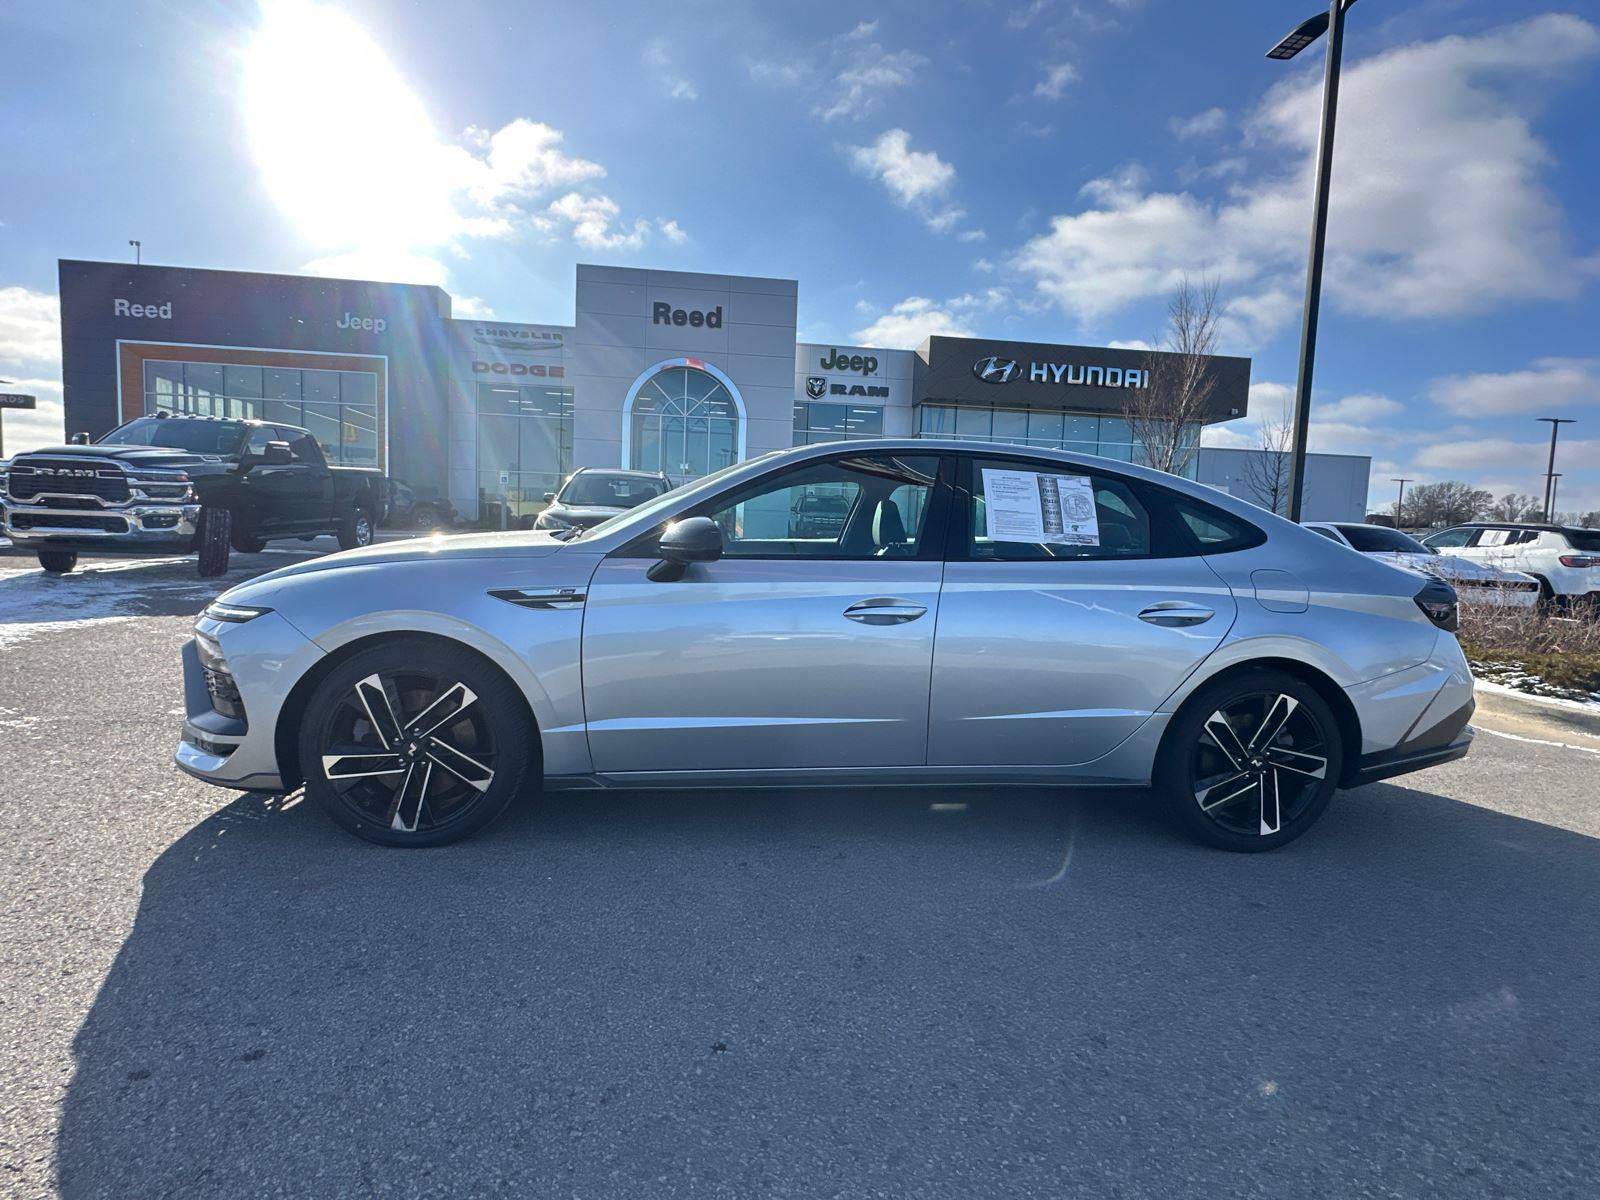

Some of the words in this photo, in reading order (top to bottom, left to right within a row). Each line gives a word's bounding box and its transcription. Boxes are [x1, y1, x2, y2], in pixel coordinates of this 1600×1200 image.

[114, 298, 172, 319] Reed
[653, 301, 722, 328] Reed
[336, 312, 386, 334] Jeep
[474, 328, 564, 341] CHRYSLER
[472, 361, 565, 378] DODGE
[820, 348, 878, 376] Jeep
[1030, 362, 1149, 389] HYUNDAI
[830, 383, 889, 398] RAM
[36, 467, 94, 477] RAM
